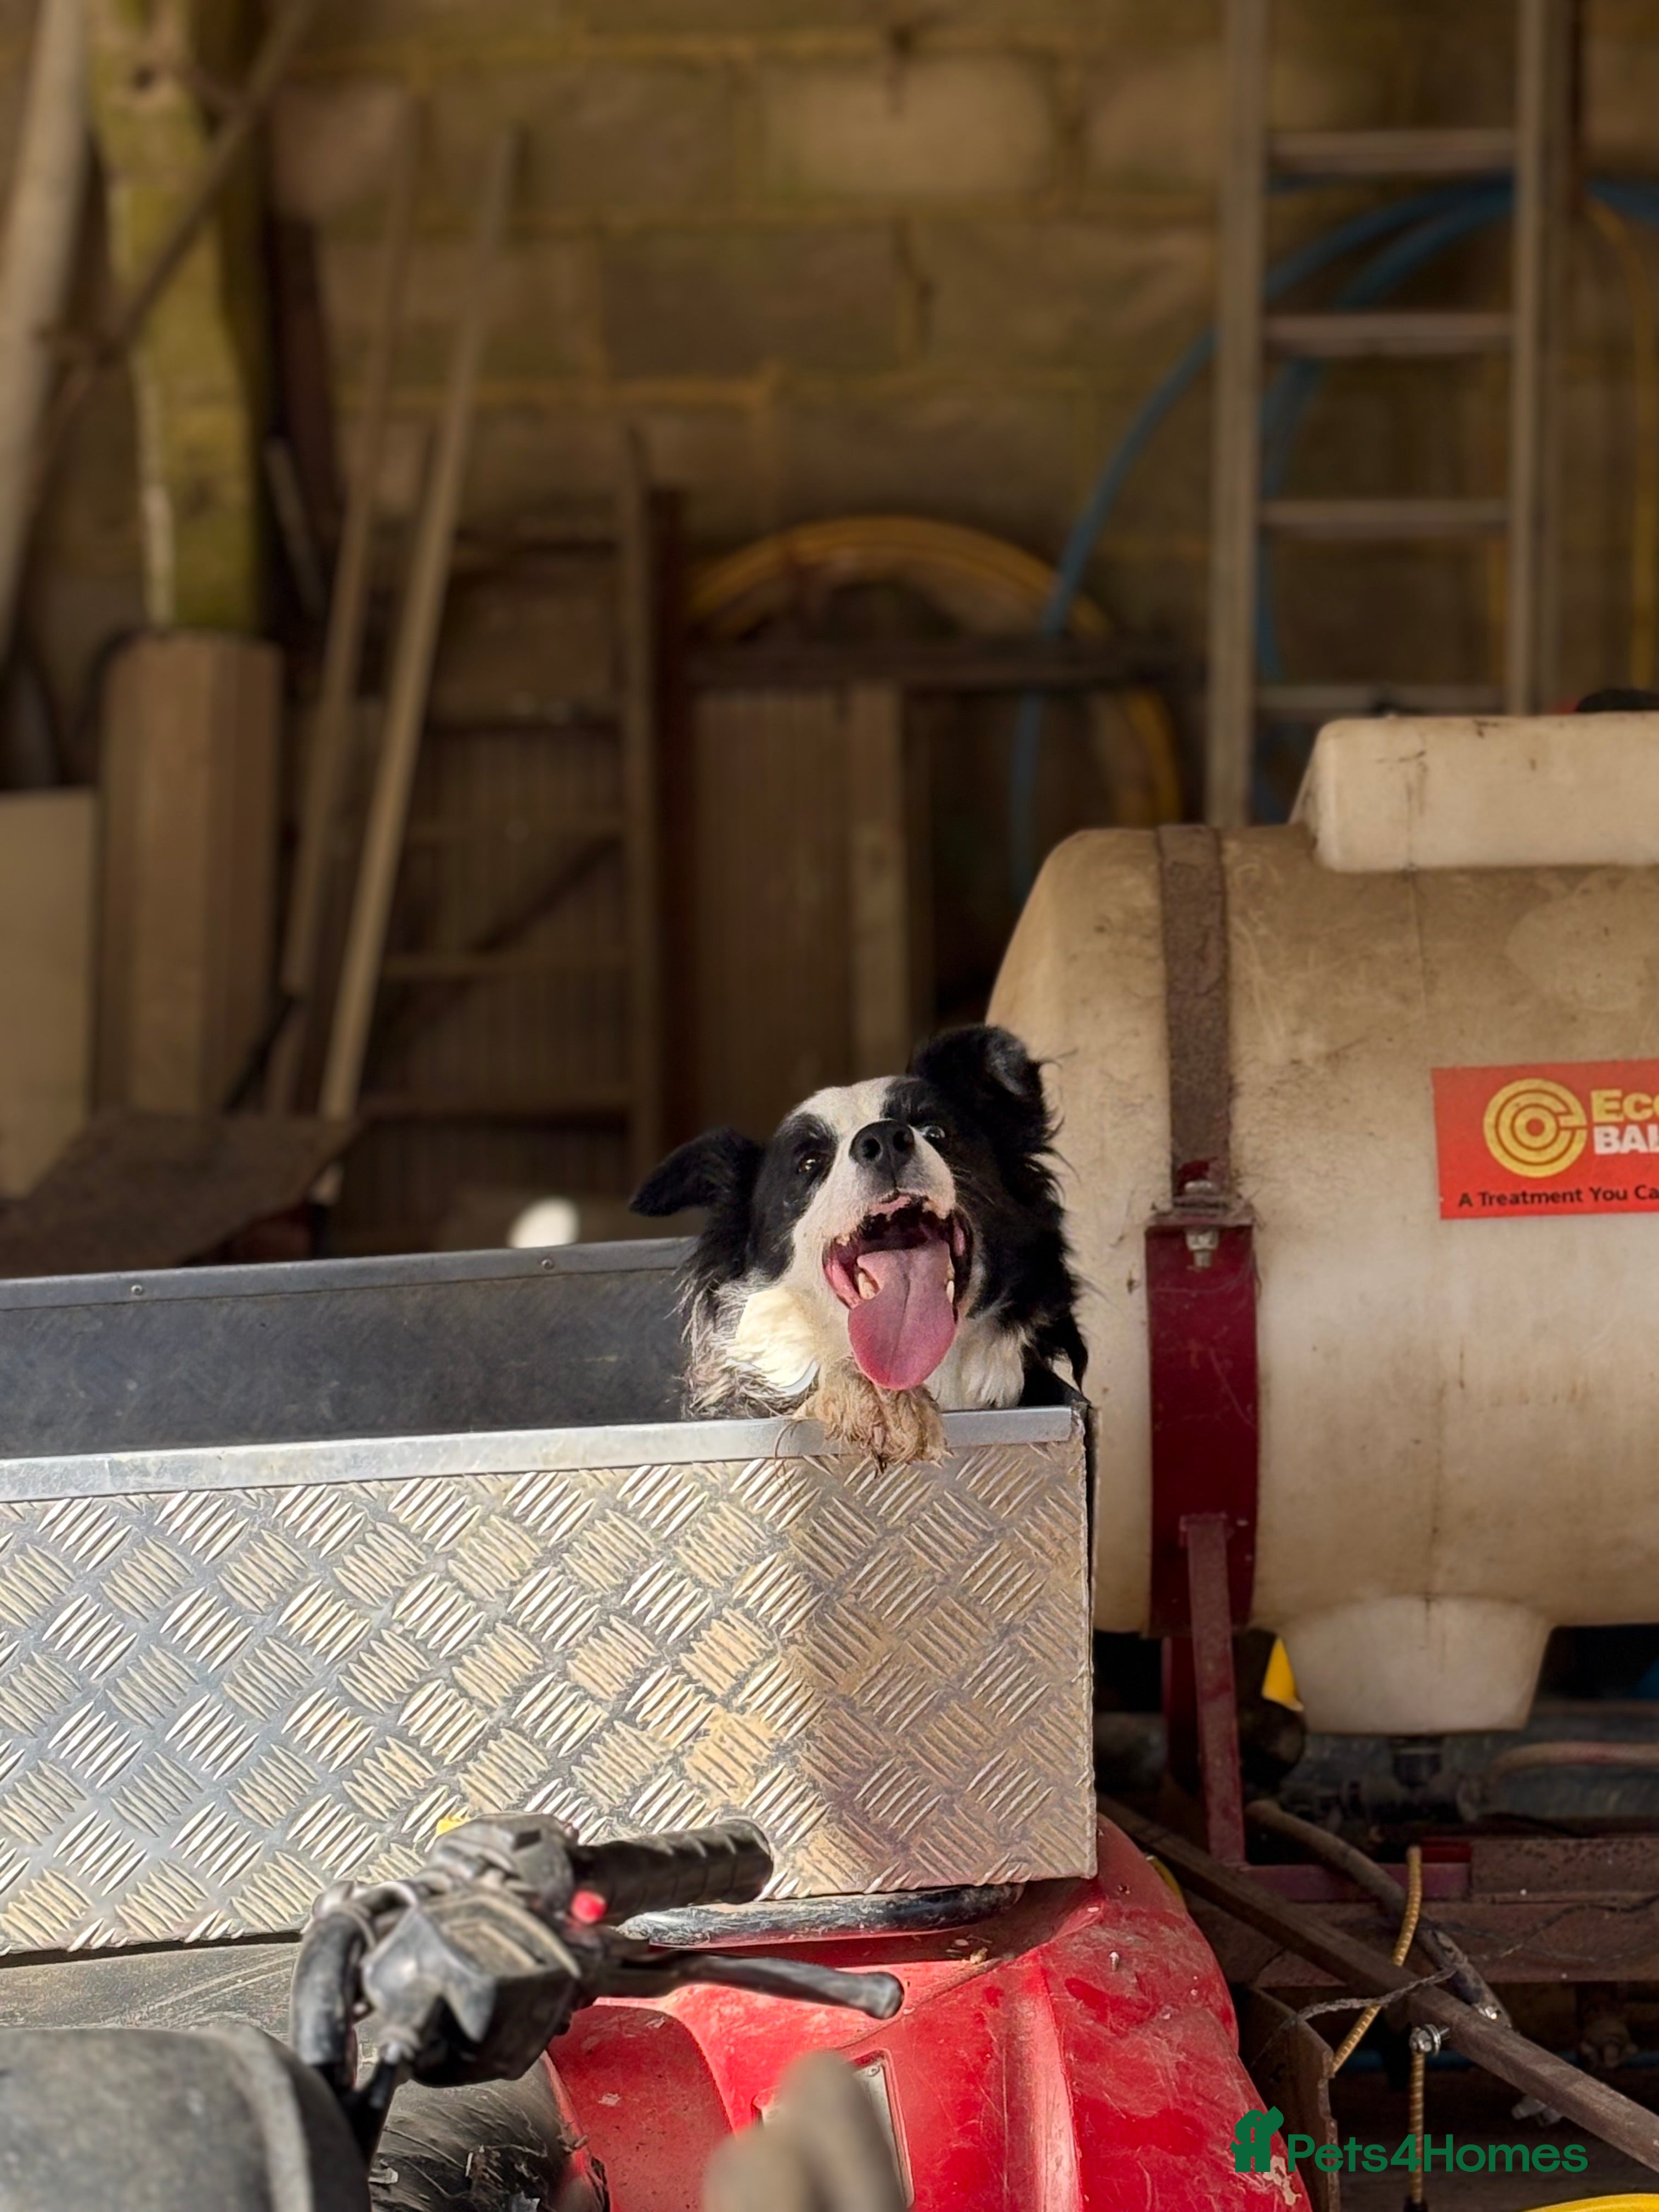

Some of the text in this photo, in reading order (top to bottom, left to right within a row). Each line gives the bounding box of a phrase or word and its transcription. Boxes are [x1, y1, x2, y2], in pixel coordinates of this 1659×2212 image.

[1591, 1089, 1659, 1122] EC
[1458, 1193, 1473, 1207] A
[1478, 1188, 1583, 1206] Treatment
[1589, 1186, 1628, 1202] You
